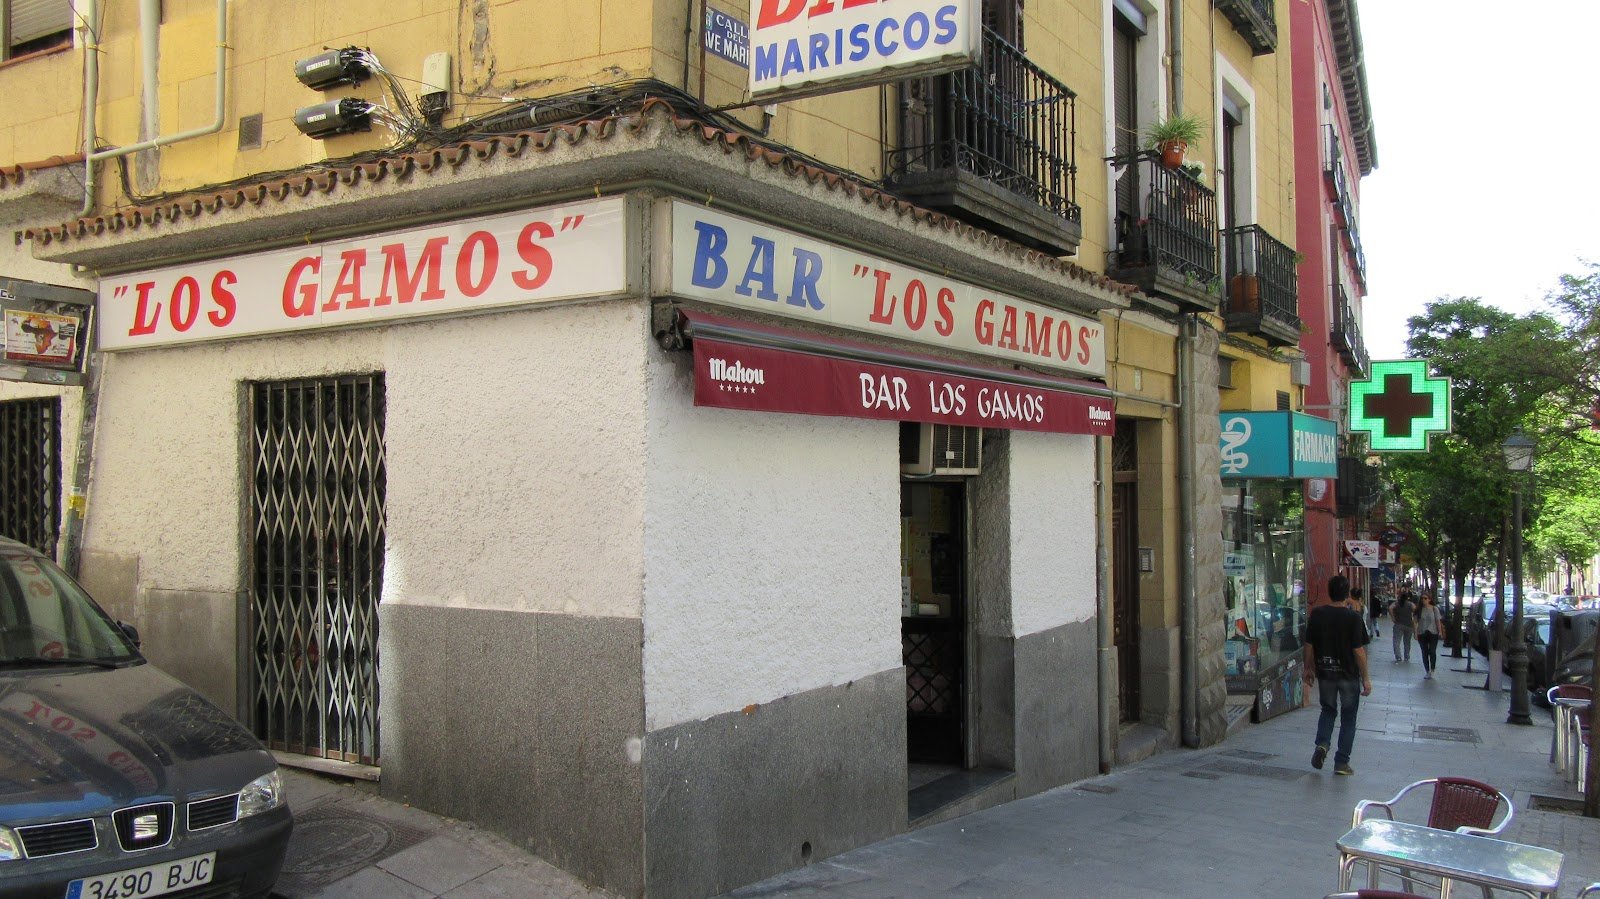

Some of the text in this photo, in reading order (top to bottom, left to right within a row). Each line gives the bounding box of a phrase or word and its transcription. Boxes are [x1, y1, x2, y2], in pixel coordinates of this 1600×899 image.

[716, 14, 750, 39] CALL
[727, 31, 743, 44] DEL
[755, 5, 957, 82] MARISCOS
[692, 220, 825, 311] BAR
[709, 357, 765, 385] Mahou
[859, 372, 1044, 423] BAR LOS GAMOS
[1089, 405, 1111, 420] Mahou
[1294, 429, 1336, 464] FARMACIA
[89, 857, 210, 899] 3490 BJC
